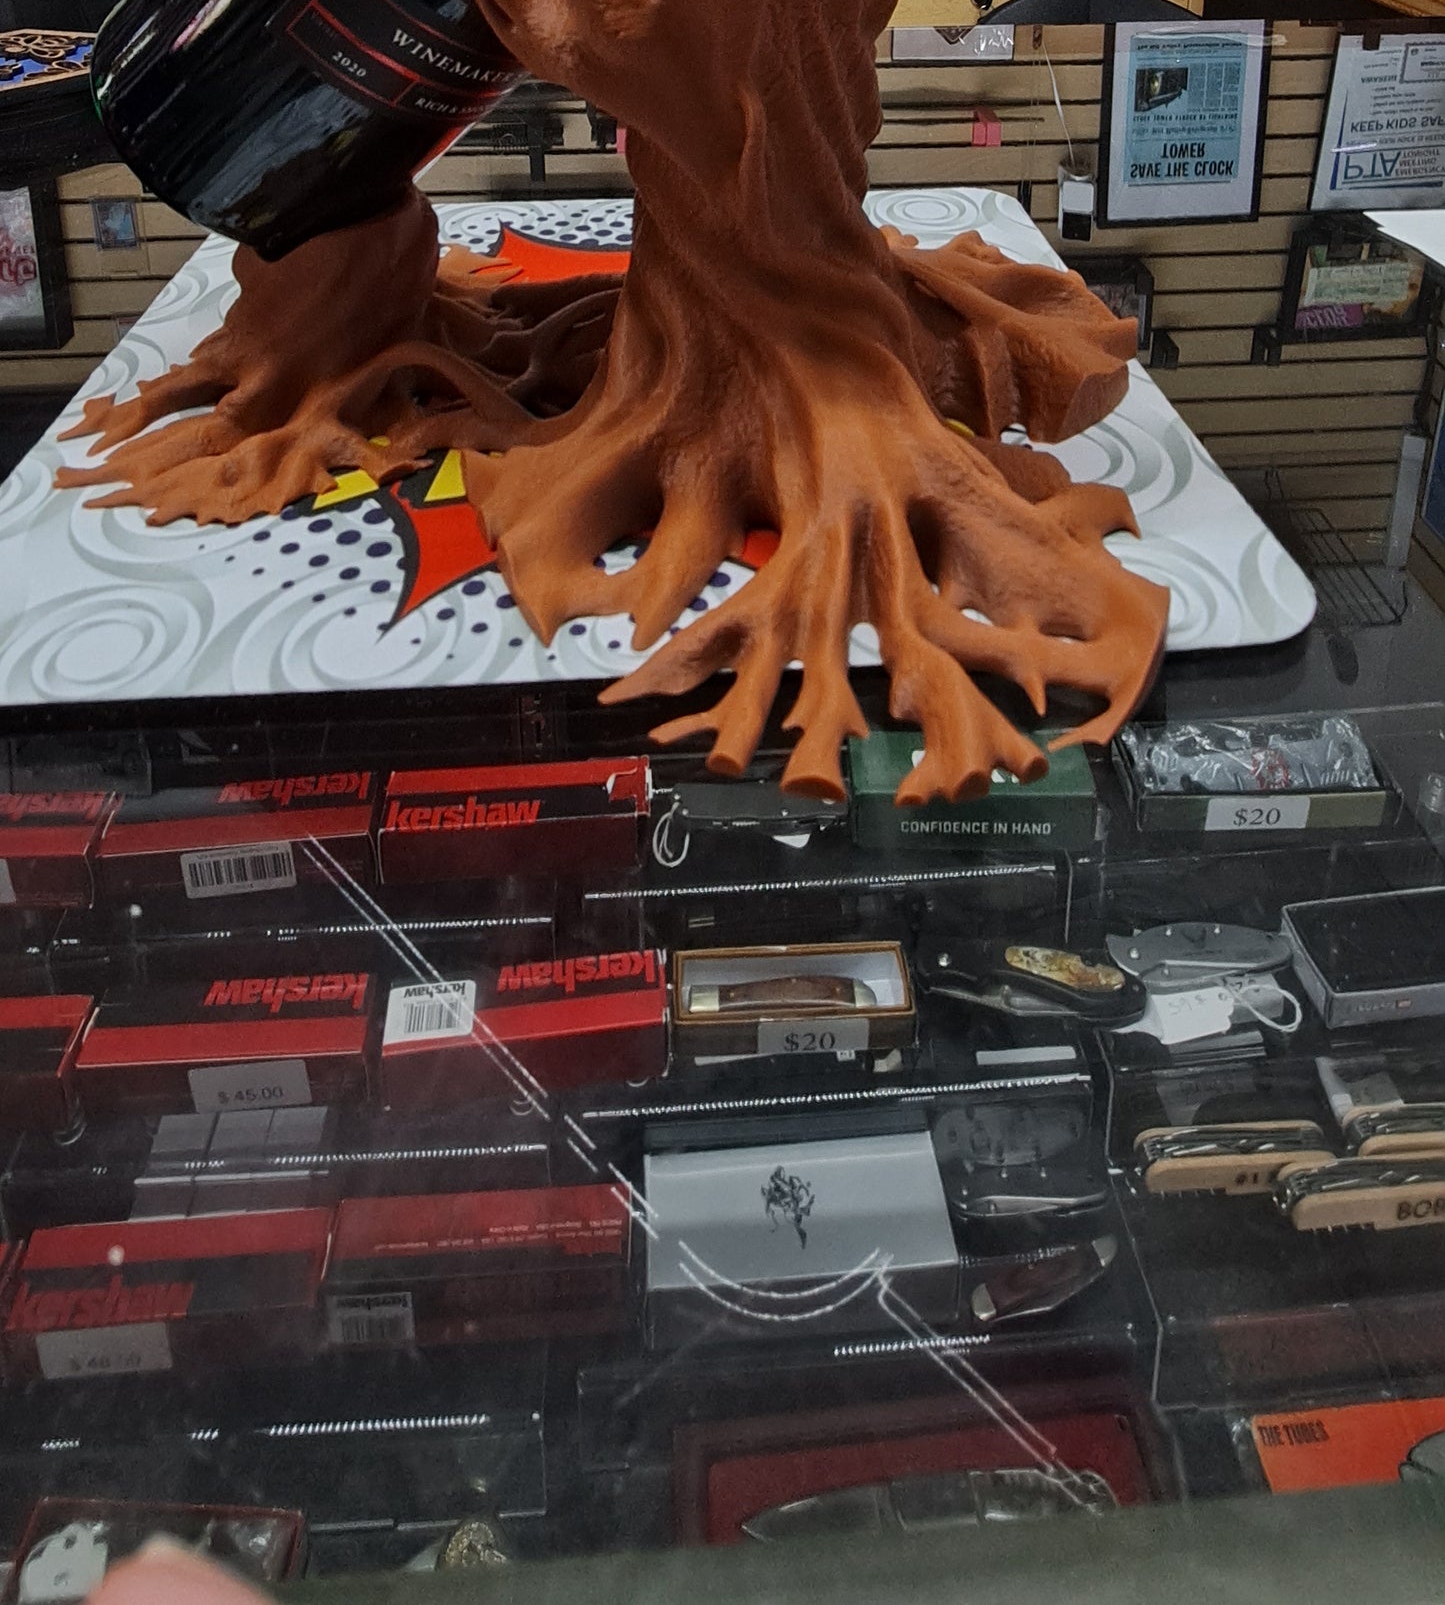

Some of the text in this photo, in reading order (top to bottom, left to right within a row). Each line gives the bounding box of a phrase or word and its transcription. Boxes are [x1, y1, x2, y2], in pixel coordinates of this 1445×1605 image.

[331, 50, 368, 78] 2020
[217, 771, 371, 806] kershaw
[385, 796, 542, 832] kershaw
[900, 821, 1052, 836] CONFIDENCE IN HAND
[1233, 807, 1281, 826] $20
[497, 950, 655, 994] kershaw
[203, 973, 370, 1013] kershaw
[783, 1032, 836, 1052] $20
[4, 1274, 195, 1333] kershaw
[1257, 1424, 1284, 1447] THE
